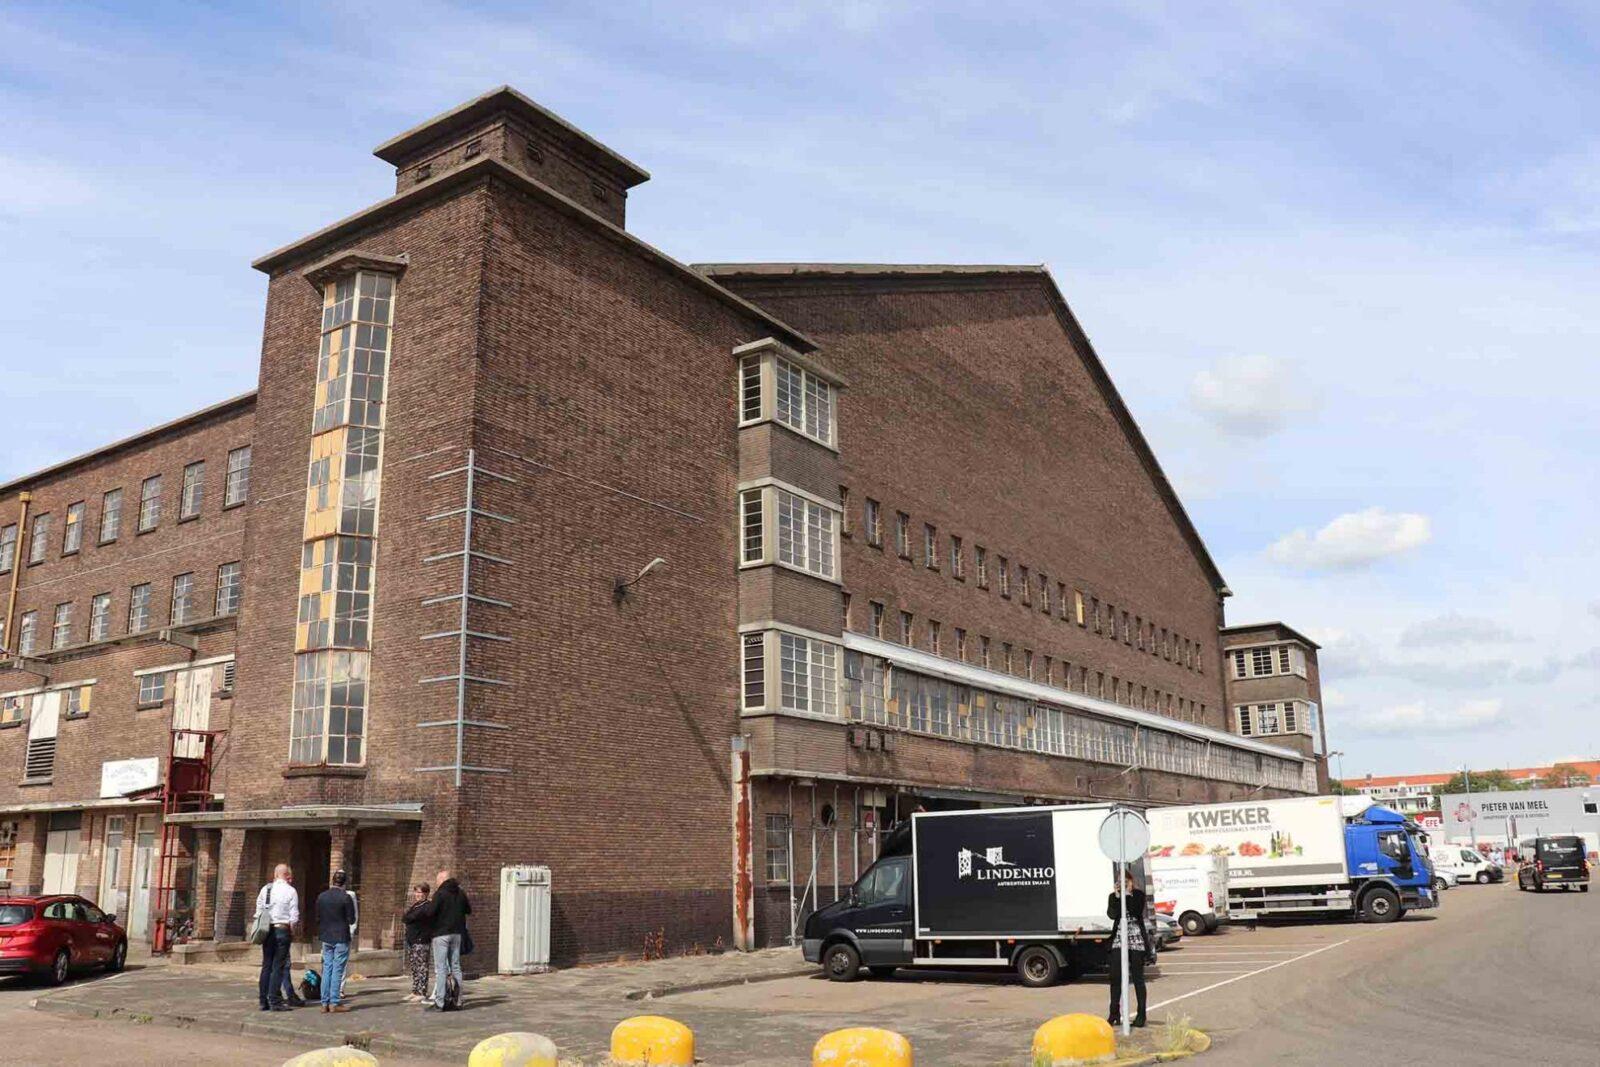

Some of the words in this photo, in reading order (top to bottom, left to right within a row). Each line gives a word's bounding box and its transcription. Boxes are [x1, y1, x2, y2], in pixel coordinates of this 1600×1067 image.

[1481, 803, 1507, 812] PIETER
[1509, 801, 1525, 811] VAN
[1527, 800, 1549, 810] MEEL
[1188, 807, 1271, 829] KWEKER
